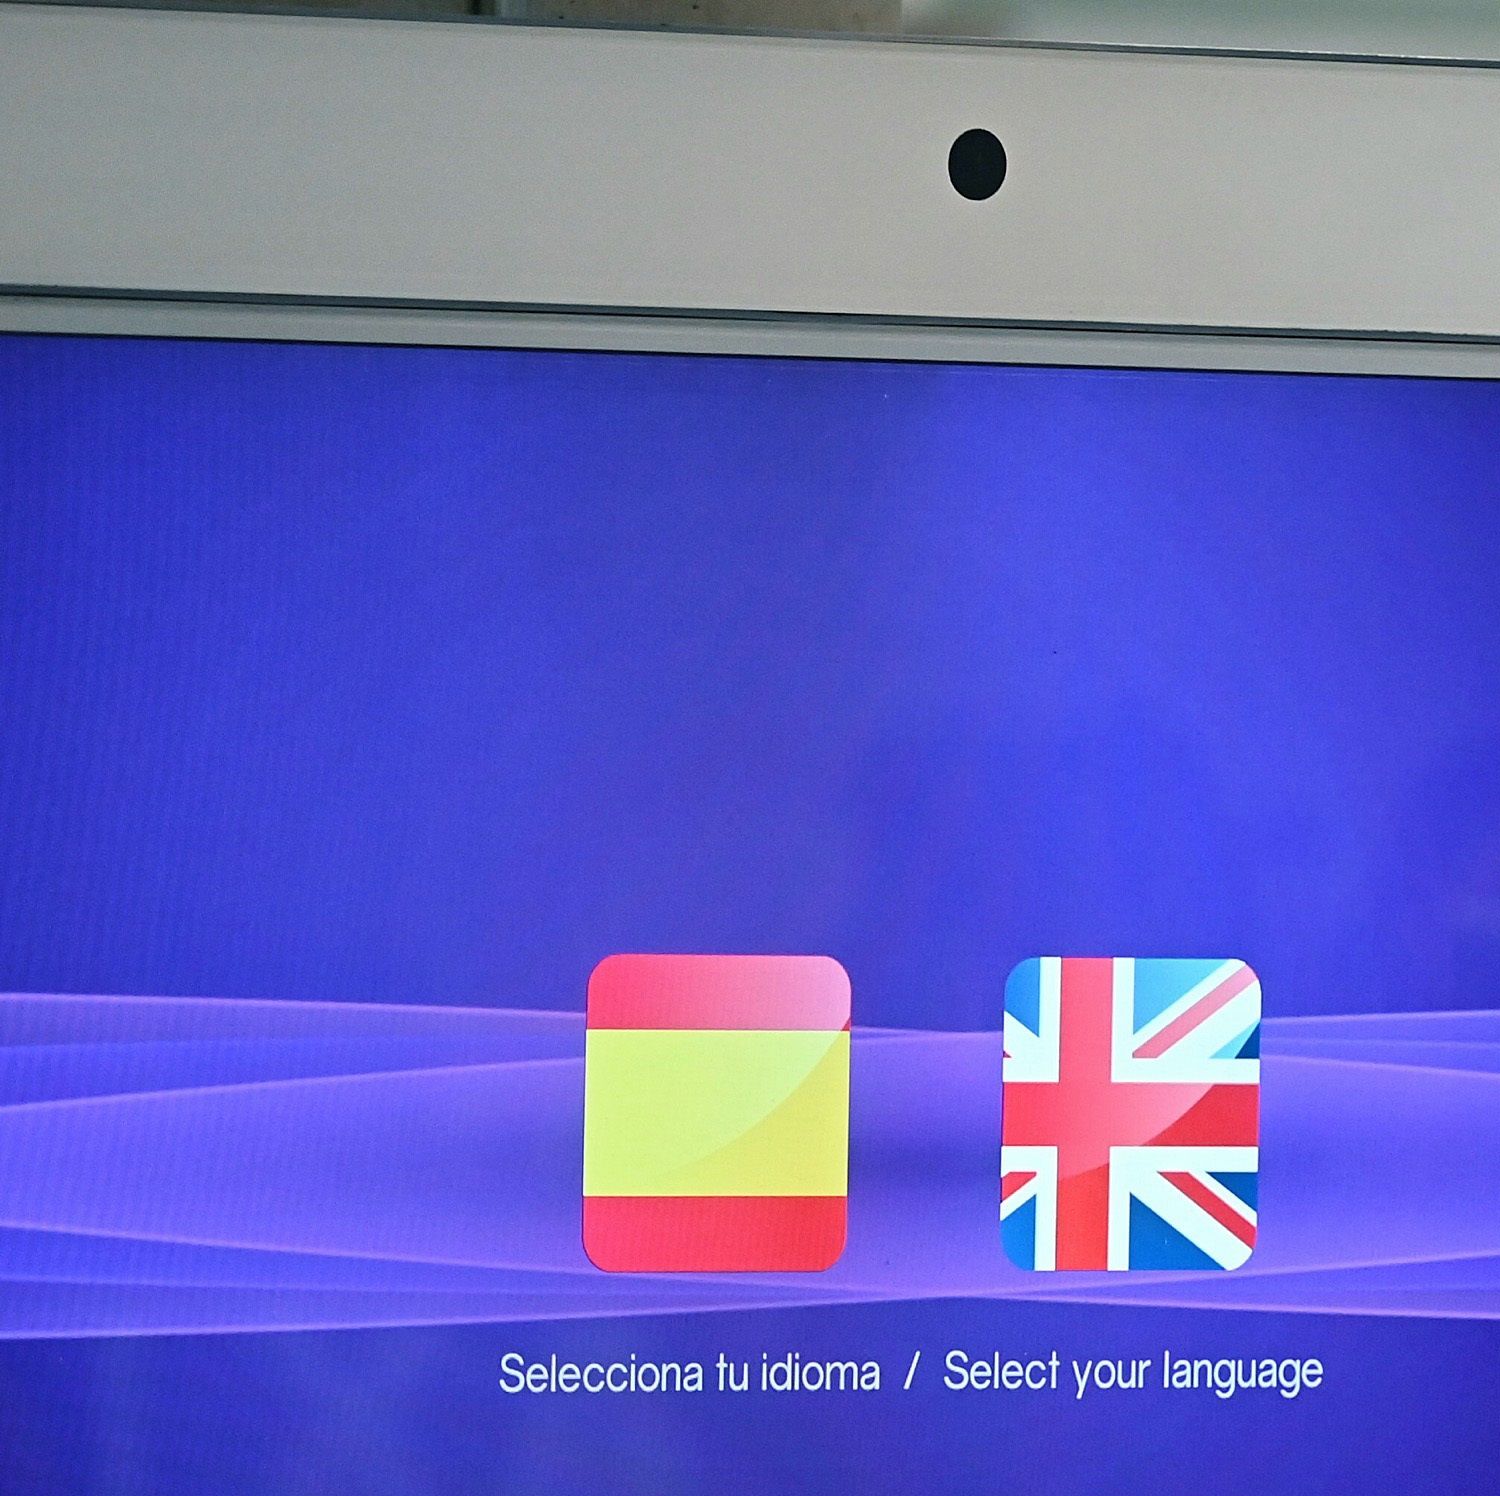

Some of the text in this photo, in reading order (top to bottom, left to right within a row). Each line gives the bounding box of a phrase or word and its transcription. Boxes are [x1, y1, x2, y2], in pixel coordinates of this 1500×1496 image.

[498, 1350, 1324, 1400] Selecciona tu idioma / Select your language
